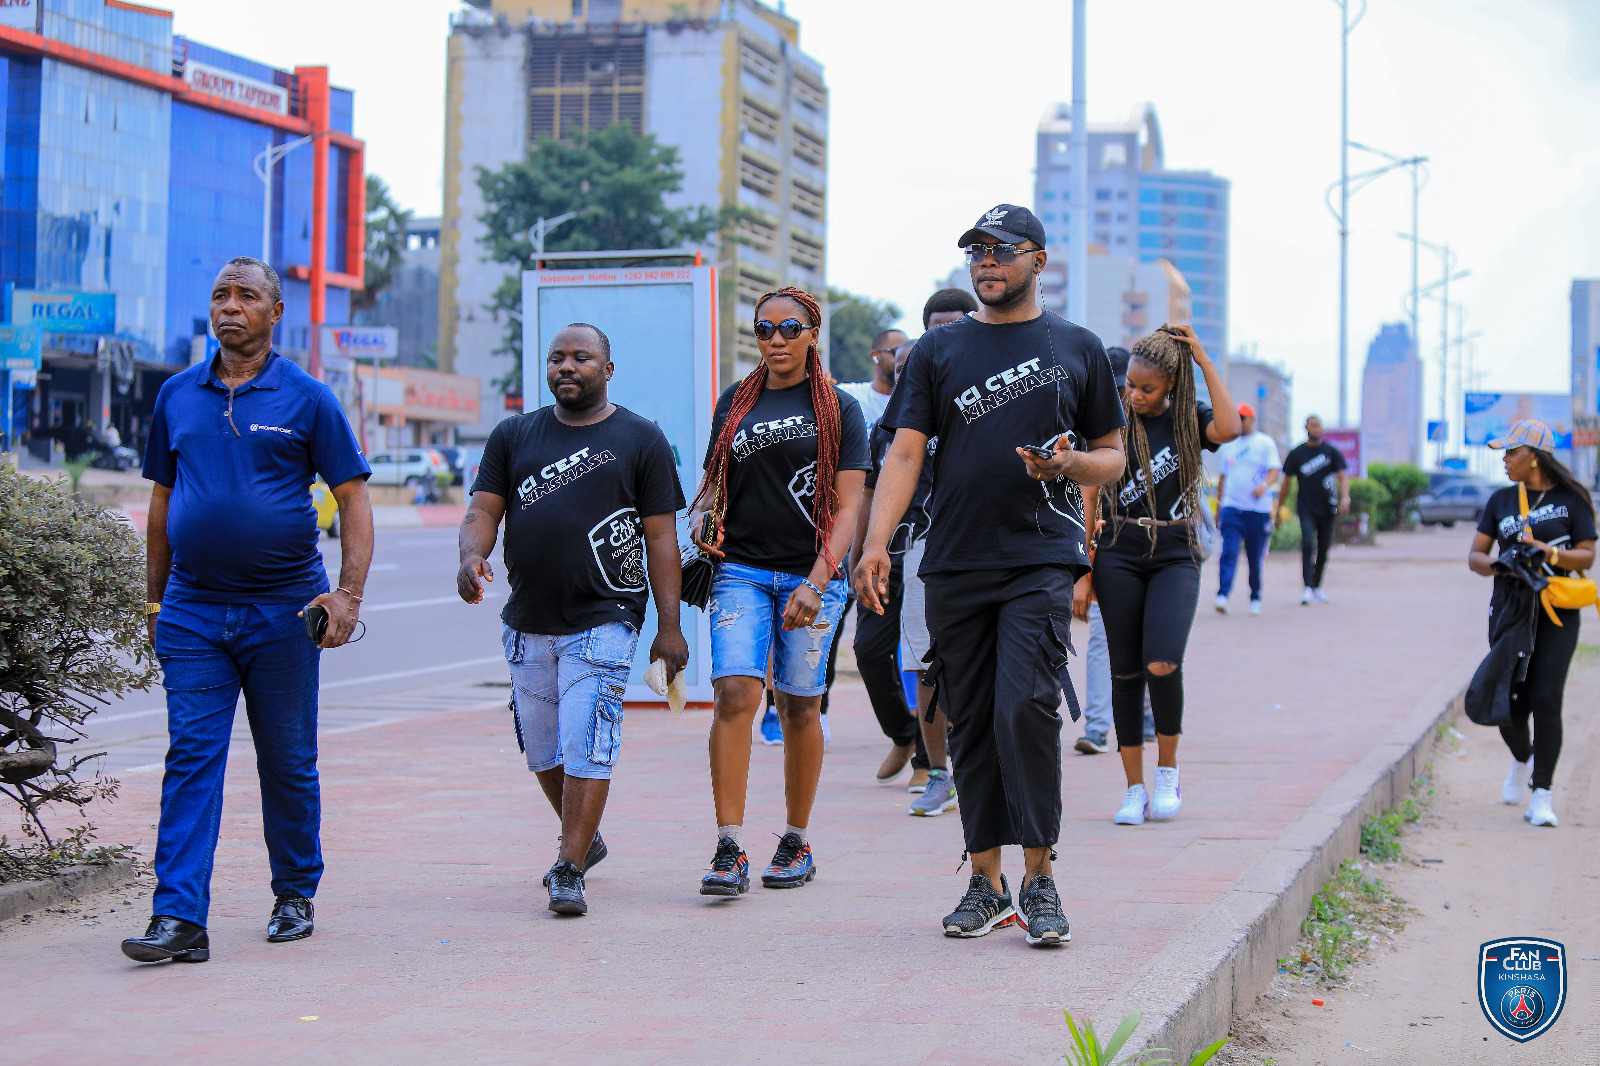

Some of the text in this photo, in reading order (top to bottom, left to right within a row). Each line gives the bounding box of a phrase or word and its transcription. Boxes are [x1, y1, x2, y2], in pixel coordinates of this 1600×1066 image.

[540, 274, 585, 283] Investment
[589, 273, 618, 281] Hotline
[32, 302, 100, 320] REGAL
[953, 356, 1041, 412] ICI C'EST
[961, 364, 1069, 425] KINSHASA
[752, 415, 805, 434] C'EST
[517, 446, 590, 499] ICI C'EST
[520, 449, 617, 511] KINSHASA
